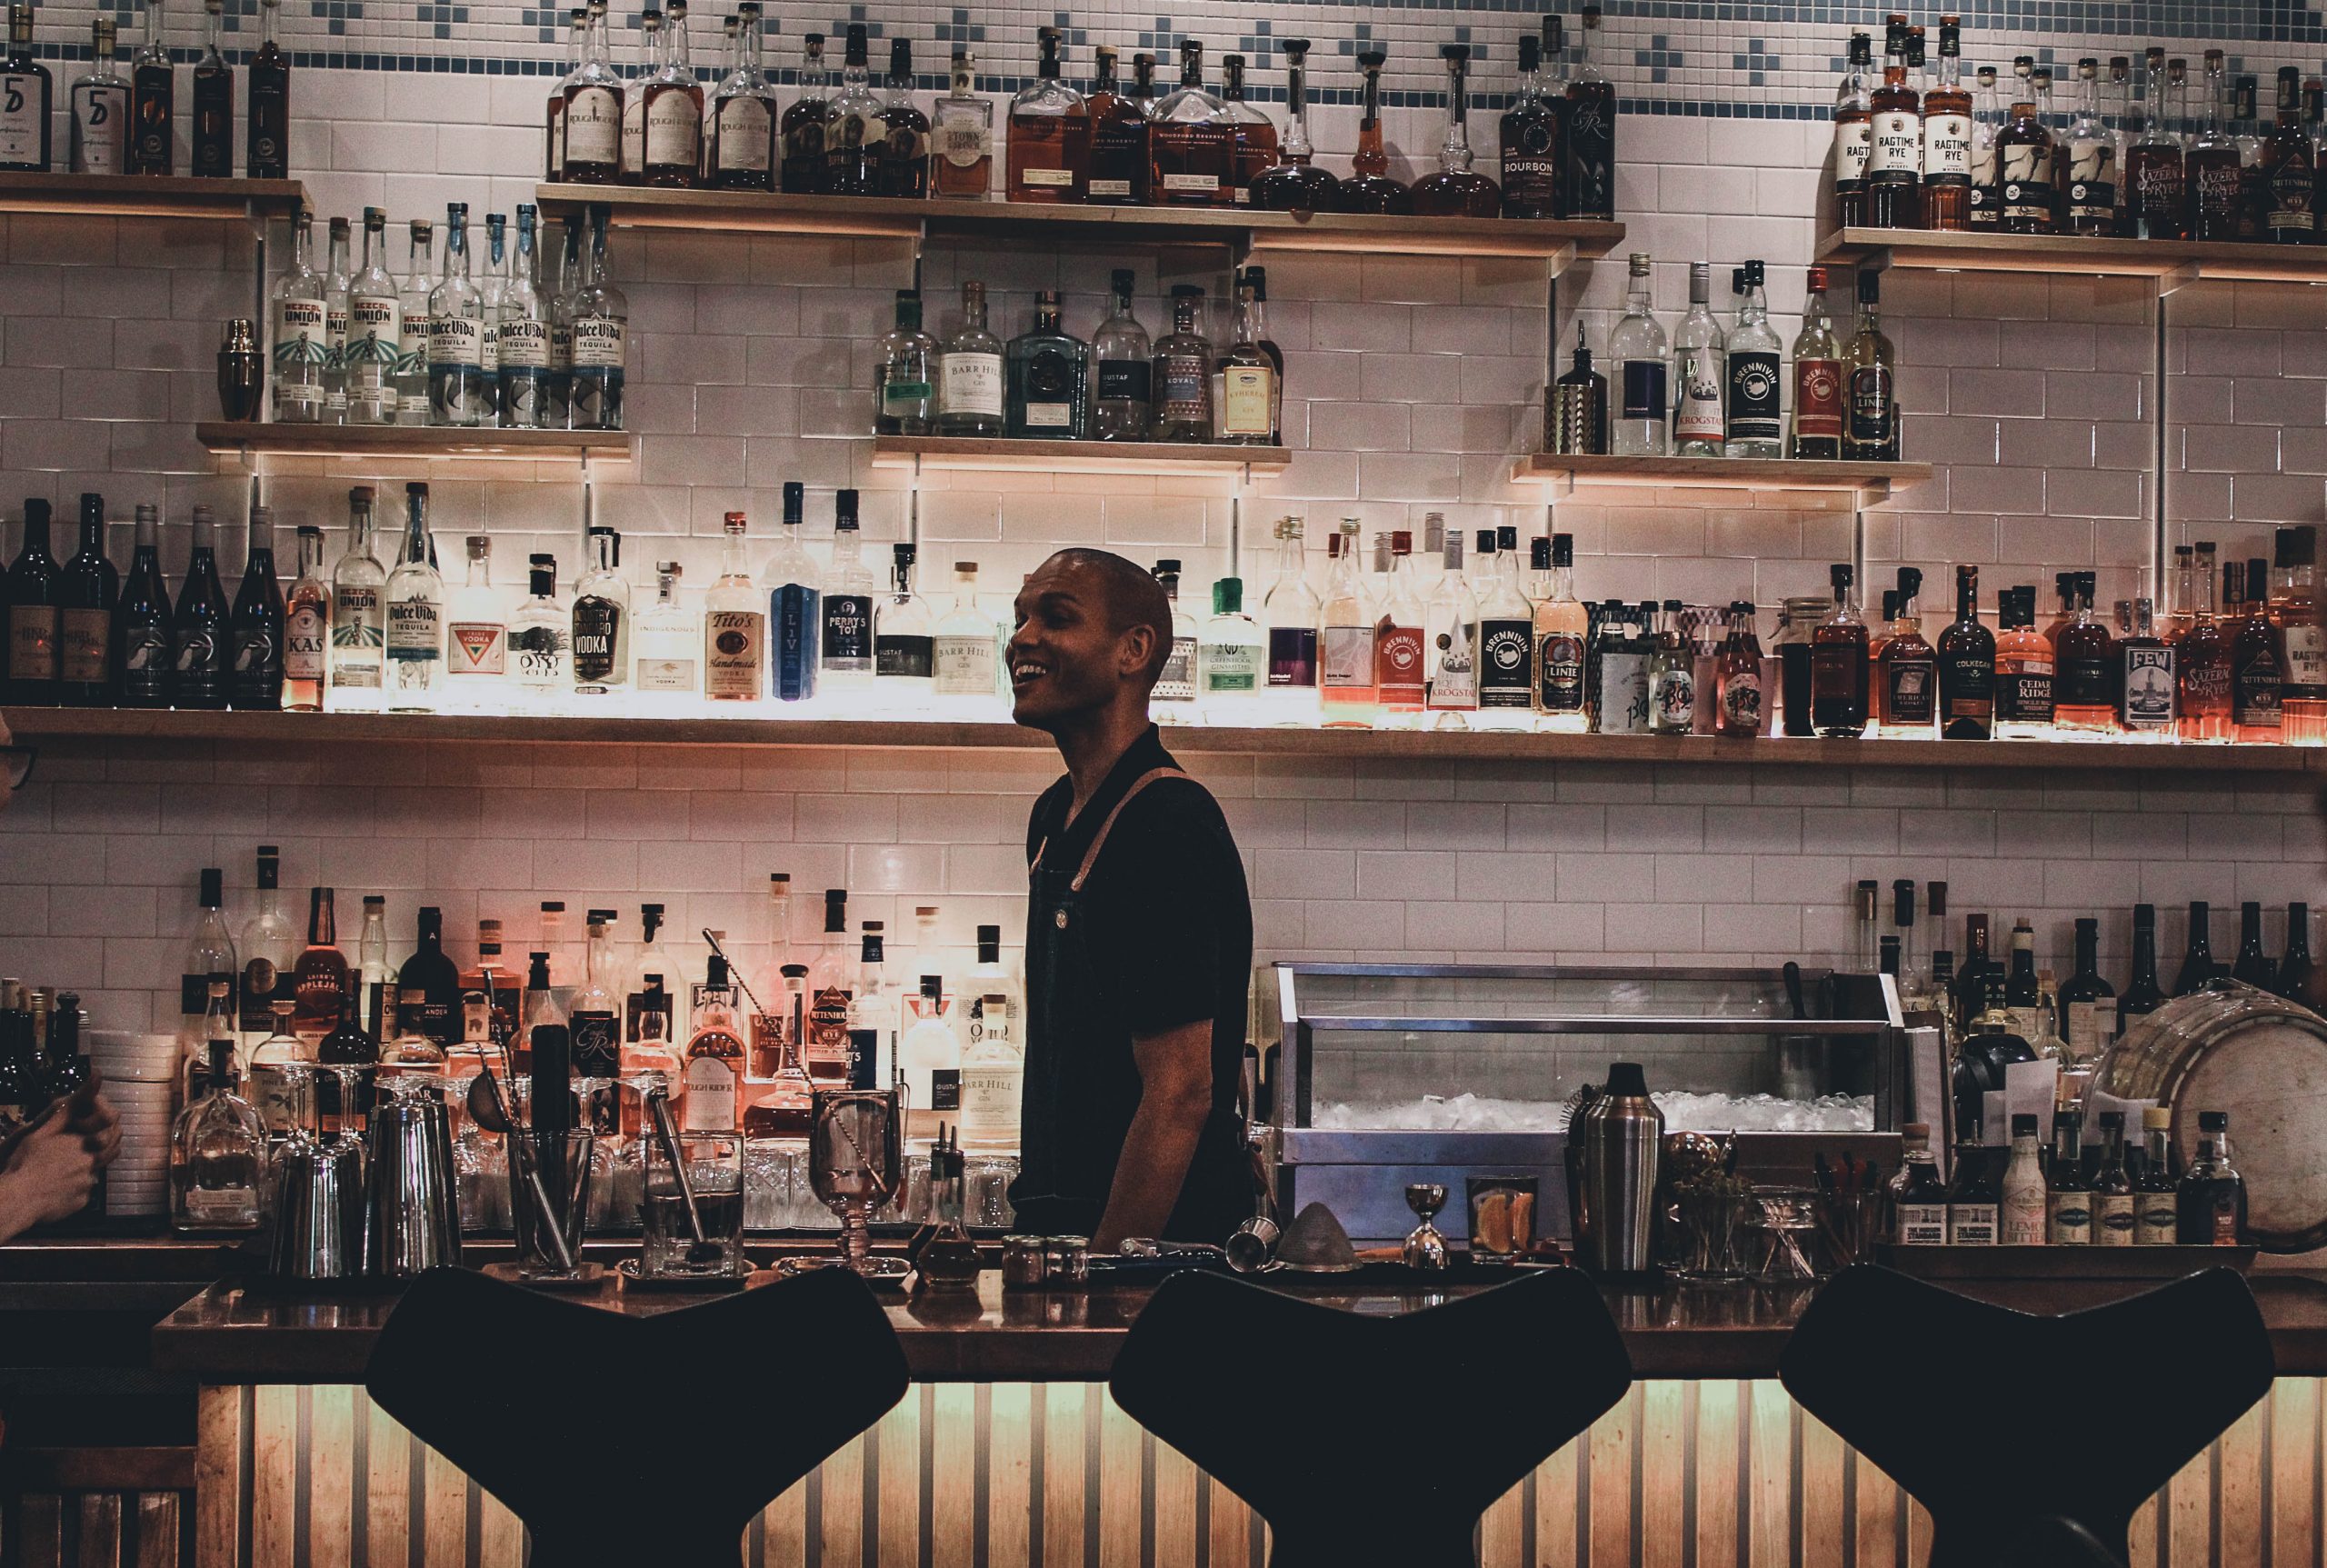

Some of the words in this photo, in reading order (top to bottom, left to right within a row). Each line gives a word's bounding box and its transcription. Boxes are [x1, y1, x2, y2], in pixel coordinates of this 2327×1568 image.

[624, 126, 643, 137] ROUG
[721, 123, 745, 133] ROUGH
[954, 130, 980, 141] TOWN
[1879, 136, 1914, 148] RAGTIME
[1934, 140, 1970, 152] RAGTIME
[1847, 145, 1871, 156] RAGT
[1888, 147, 1906, 158] RYE
[1857, 157, 1870, 167] RY
[1944, 151, 1962, 162] RYE
[1504, 163, 1553, 173] BOURBON
[952, 365, 980, 376] BARR
[982, 365, 999, 376] HIL
[414, 604, 437, 622] Vida
[713, 613, 754, 629] Tito's
[838, 624, 858, 636] TOT
[462, 635, 489, 644] VODKA
[575, 635, 608, 654] VODKA
[288, 638, 323, 653] KAS
[838, 648, 858, 656] GIN
[939, 646, 964, 658] BARR
[520, 654, 558, 669] OYO
[710, 657, 758, 669] Handmade
[1955, 660, 1992, 669] COLKEGAN
[2132, 651, 2169, 669] FEW
[1550, 666, 1578, 677] LINIE
[2303, 662, 2320, 673] RYE
[2018, 679, 2052, 689] CEDAR
[2019, 688, 2052, 698] RIDGE
[297, 981, 340, 994] APPLEJAC
[986, 1080, 1013, 1091] HILL
[1907, 1232, 1942, 1240] STANDARD
[1956, 1232, 1992, 1240] STANDARD
[2007, 1232, 2044, 1243] BITTE
